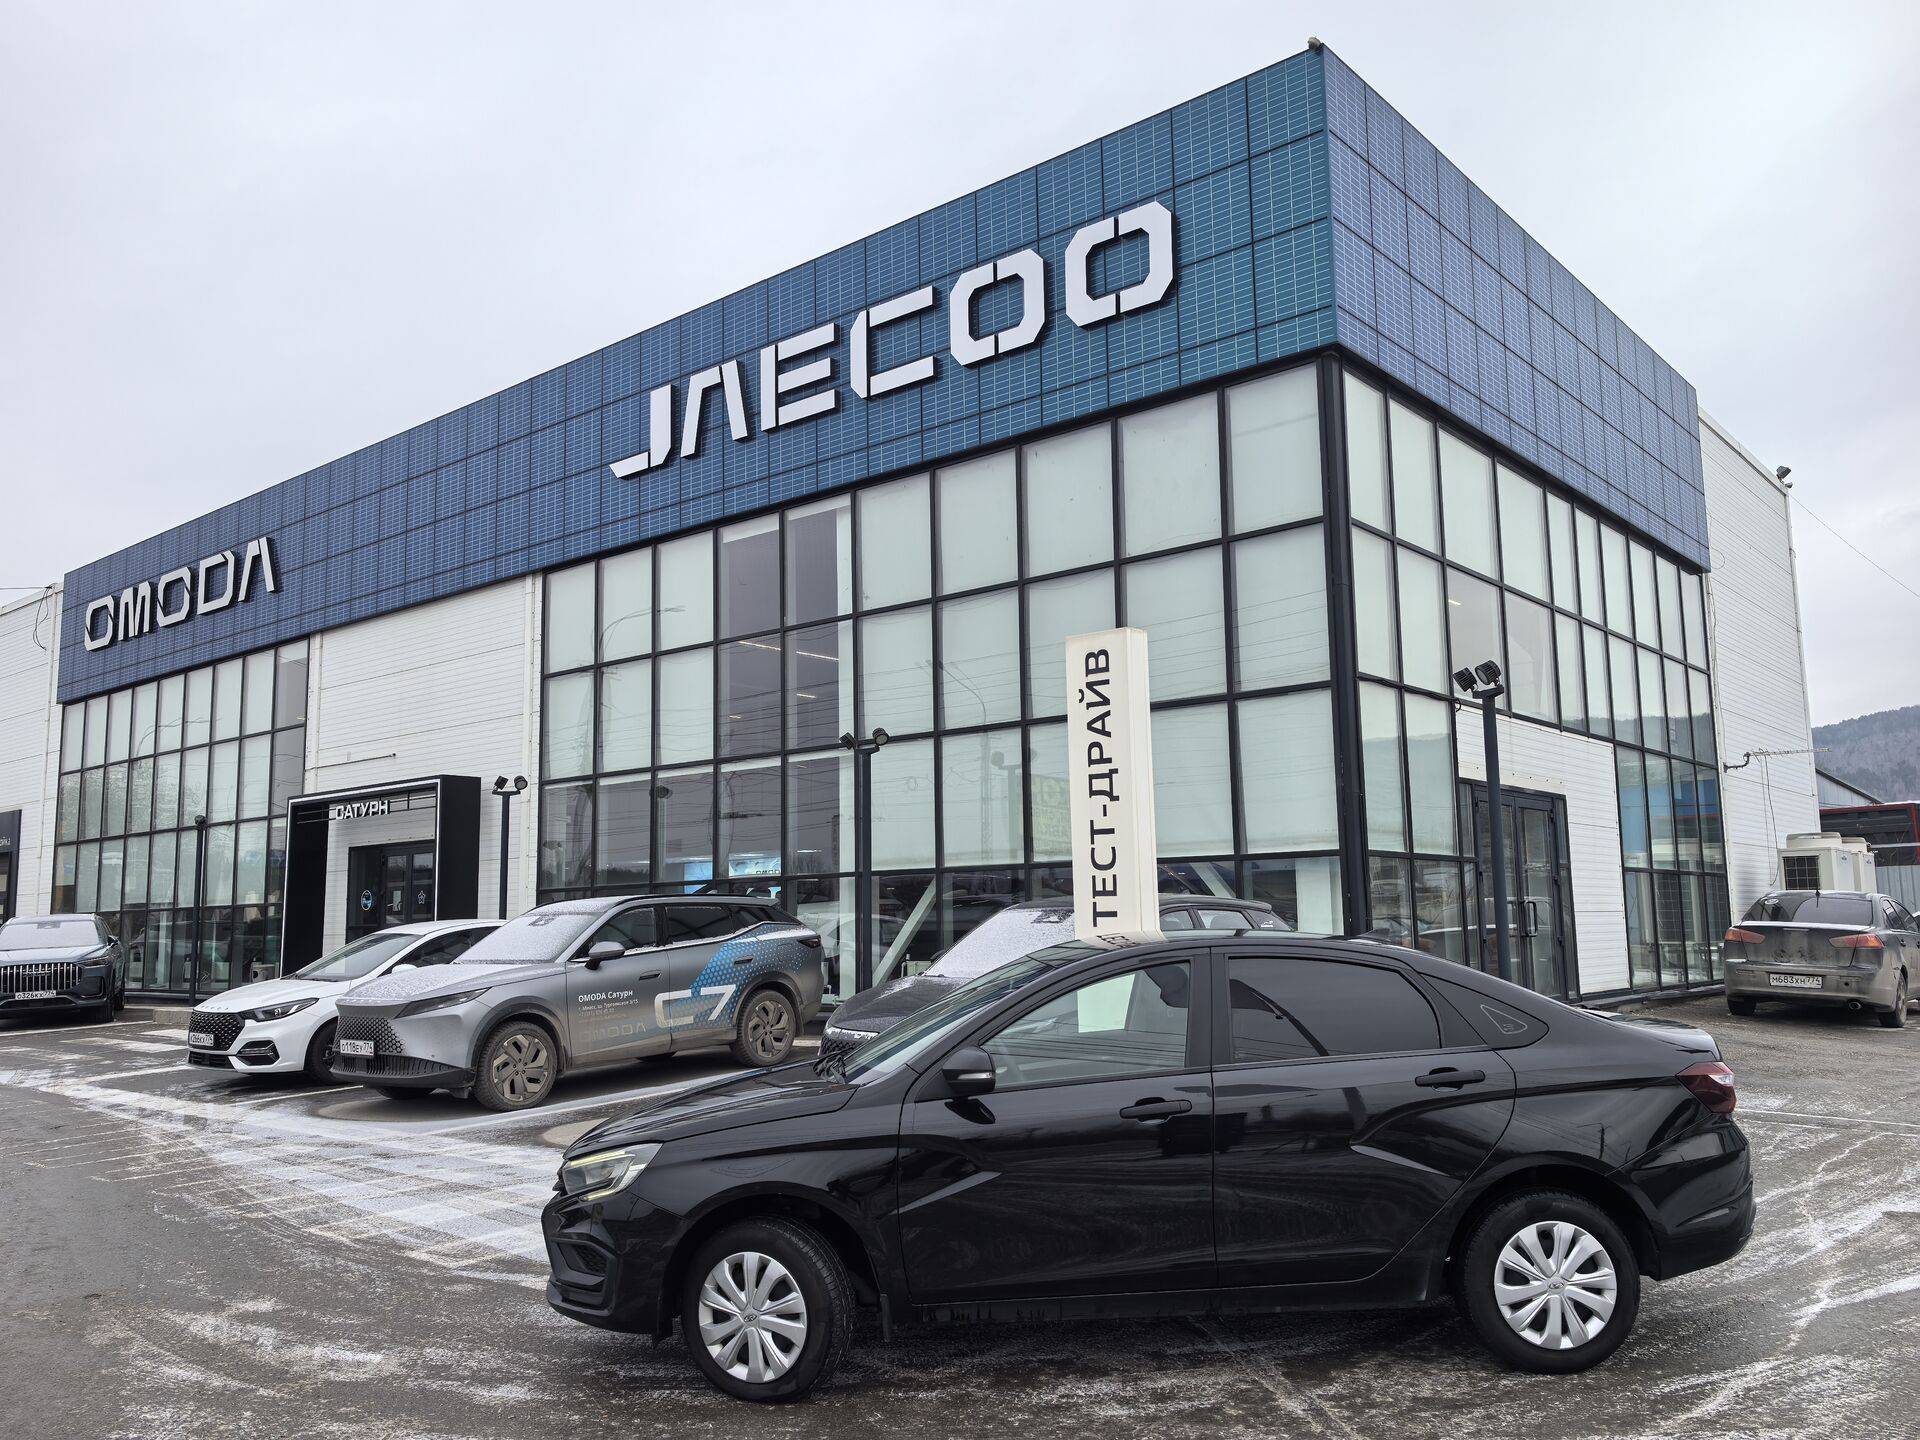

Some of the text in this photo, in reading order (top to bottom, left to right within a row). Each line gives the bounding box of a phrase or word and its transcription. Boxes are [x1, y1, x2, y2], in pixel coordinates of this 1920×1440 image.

[609, 200, 1174, 479] JAECOO
[84, 536, 275, 651] OMODA
[335, 800, 389, 820] САТУРН
[1079, 648, 1120, 927] ТЕСТ-ДРАЙВ
[578, 990, 633, 1003] OMODA Сатурн
[654, 984, 737, 1028] C7
